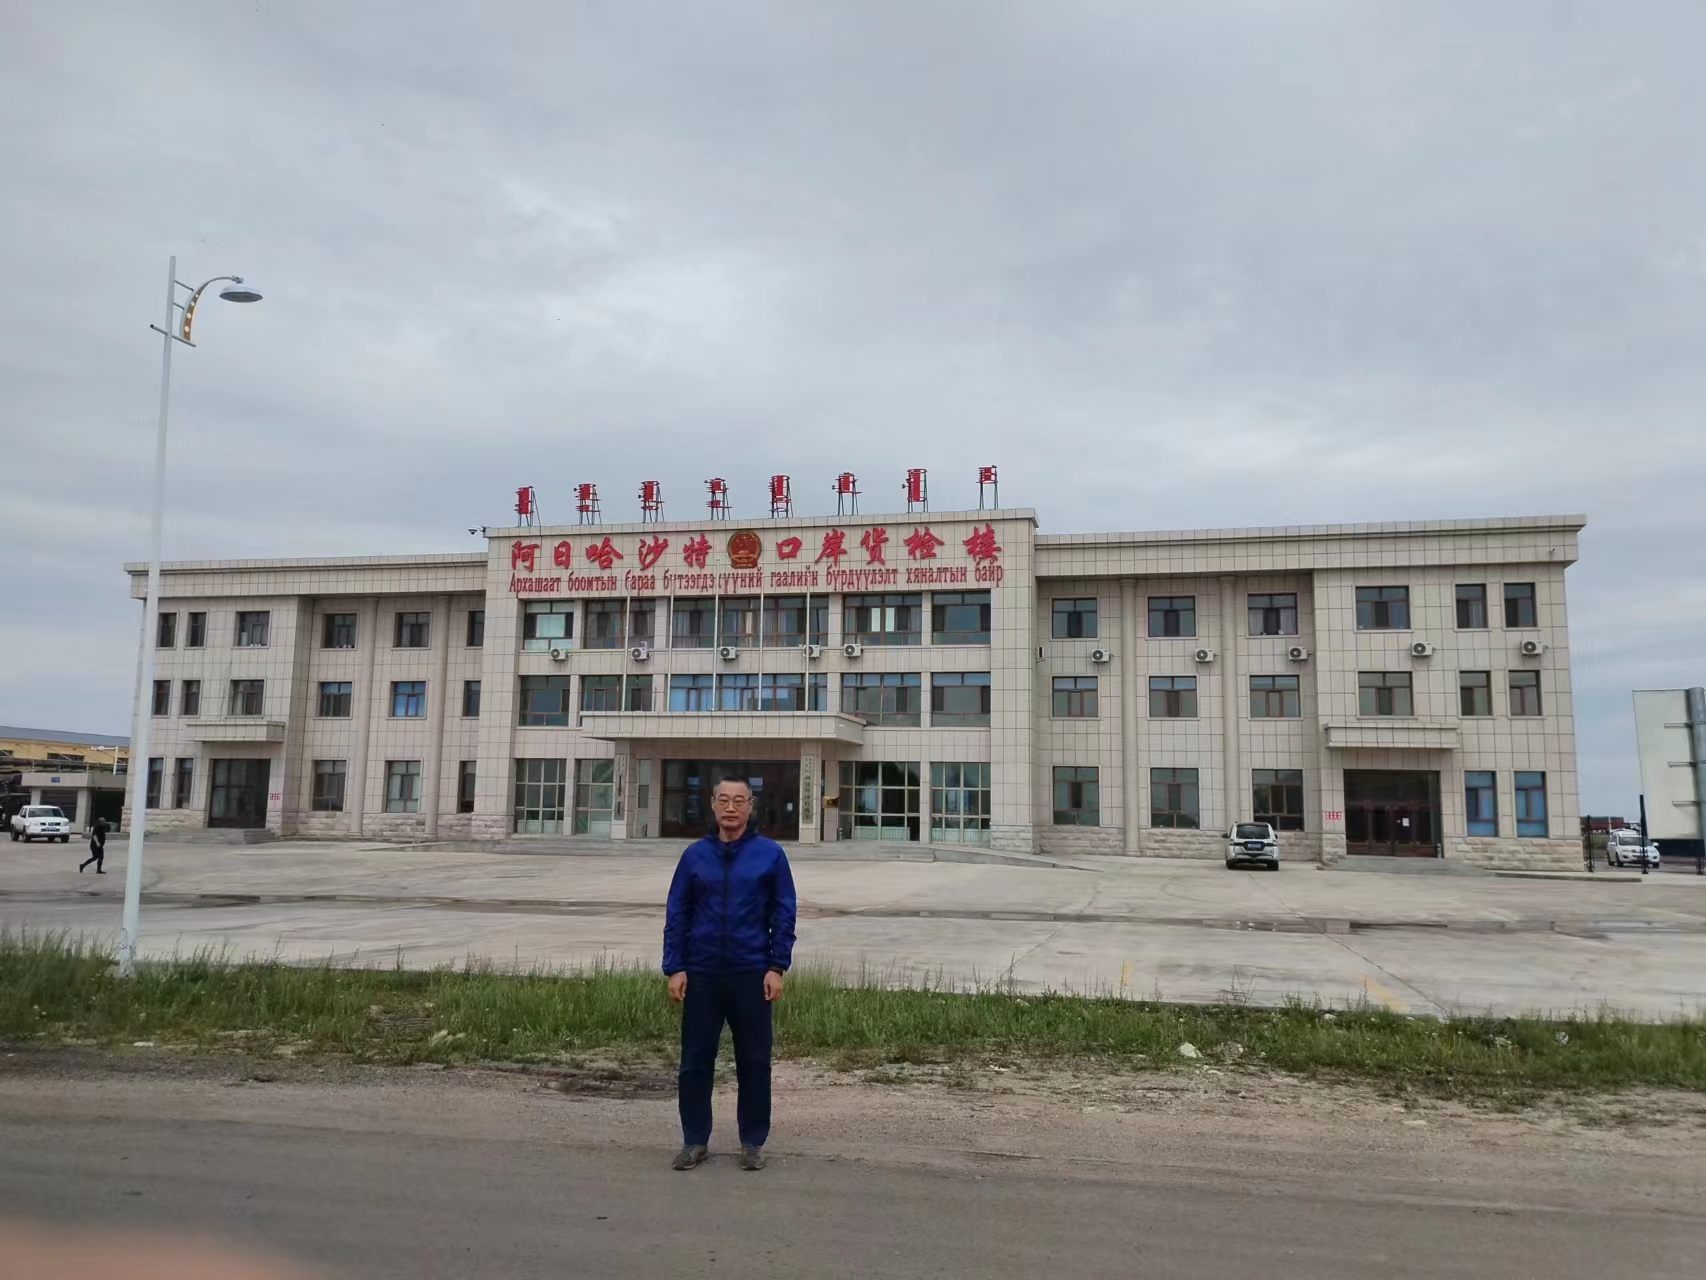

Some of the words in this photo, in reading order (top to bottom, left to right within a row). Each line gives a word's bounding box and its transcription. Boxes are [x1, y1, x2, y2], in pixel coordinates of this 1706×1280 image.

[511, 534, 712, 573] 阿日哈沙特
[776, 522, 1002, 567] 口岸货检楼
[509, 572, 562, 597] Архашаат
[568, 570, 617, 592] боомтын
[625, 569, 656, 595] бараа
[906, 564, 967, 584] хяналтын
[975, 557, 1003, 588] байр
